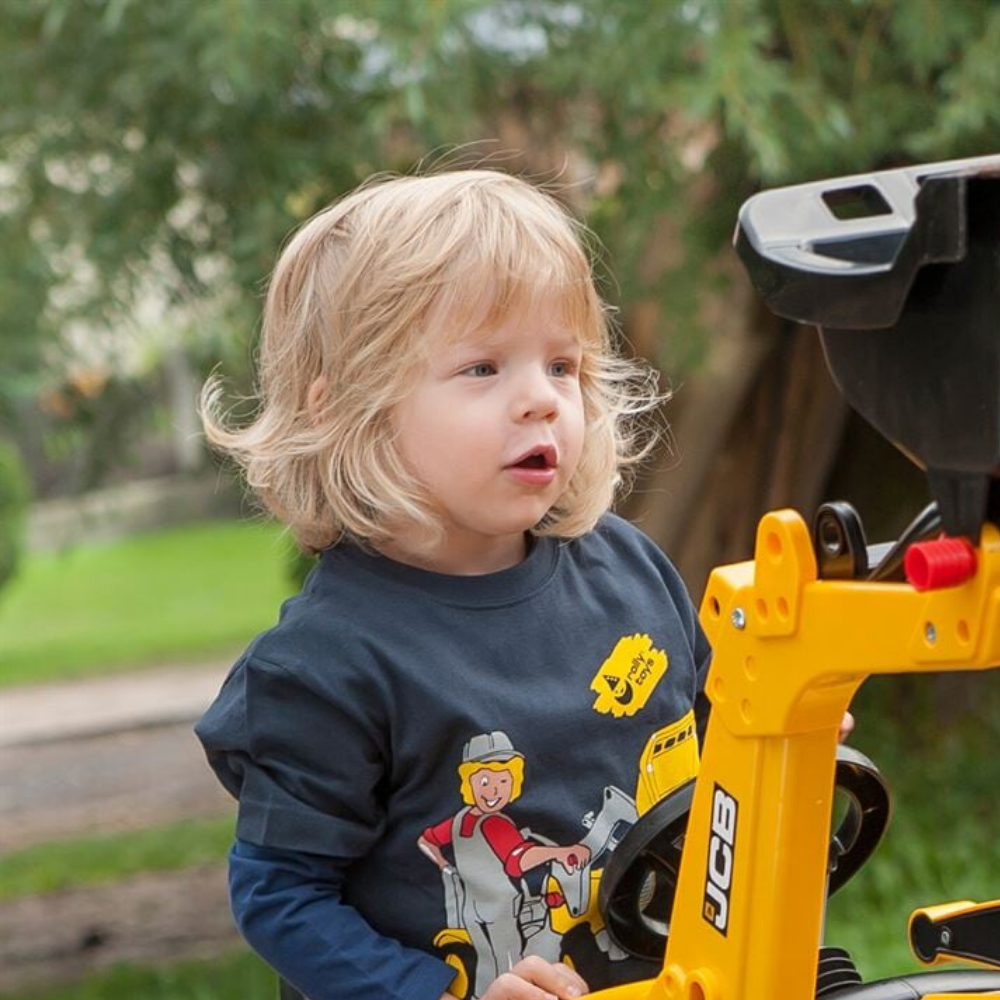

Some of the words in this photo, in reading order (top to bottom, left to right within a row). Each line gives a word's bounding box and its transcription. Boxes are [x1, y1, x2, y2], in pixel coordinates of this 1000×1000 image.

[626, 653, 646, 681] rolly
[635, 657, 654, 686] toys
[705, 789, 737, 930] JCB
